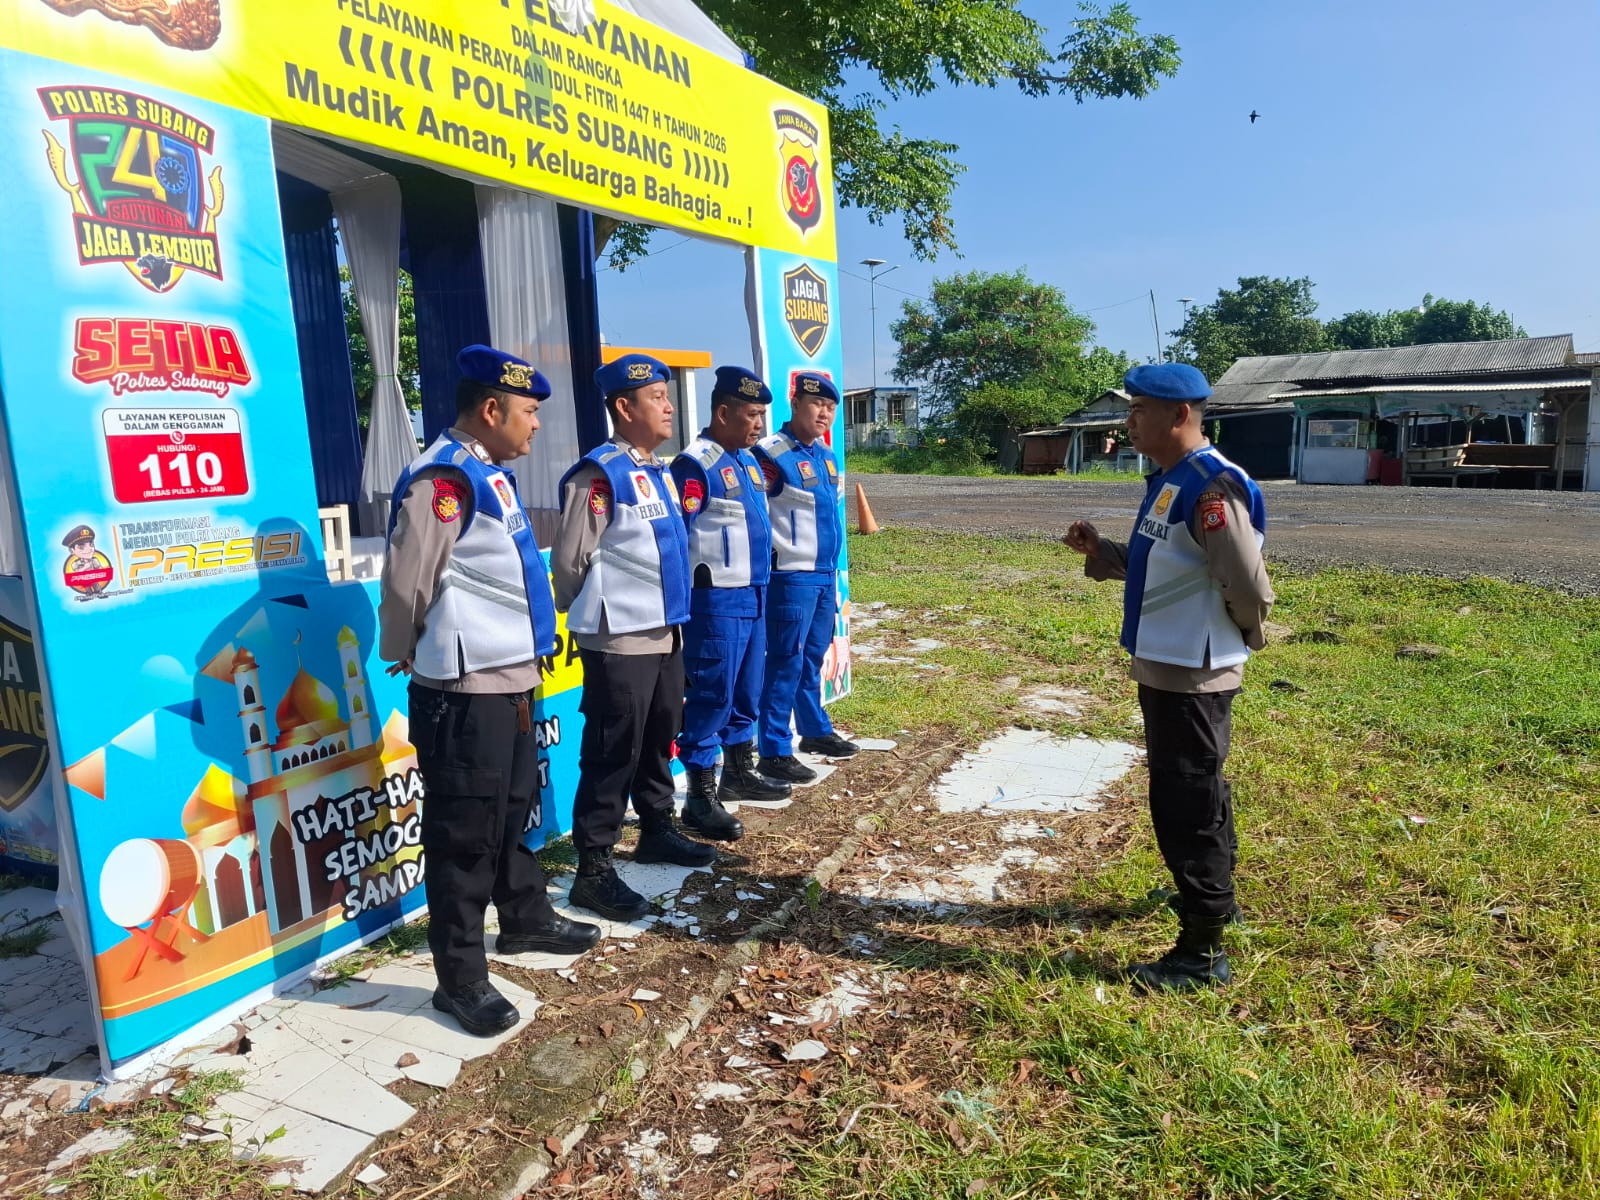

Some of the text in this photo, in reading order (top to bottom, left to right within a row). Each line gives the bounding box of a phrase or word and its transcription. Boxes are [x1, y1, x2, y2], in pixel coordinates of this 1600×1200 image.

[511, 24, 624, 89] DALAM RANGKA
[459, 33, 545, 86] PERAYAAN
[549, 68, 583, 100] IDUL
[584, 82, 619, 114] FITRI
[622, 97, 650, 125] 1447
[652, 109, 662, 130] H
[664, 113, 702, 145] TAHUN
[703, 129, 728, 154] 2026
[49, 90, 210, 148] POLRES SUBANG
[451, 65, 674, 169] POLRES SUBANG
[777, 113, 816, 139] JAWA BARAT
[285, 61, 407, 132] Mudik
[416, 105, 518, 169] Aman,
[526, 138, 637, 199] Keluarga
[643, 174, 722, 221] Bahagia
[80, 220, 218, 273] JAGA LEMBUR
[792, 278, 820, 301] JAGA
[785, 298, 828, 324] SUBANG
[74, 317, 250, 383] SETIA
[112, 370, 228, 395] Polres Subang
[118, 413, 226, 421] LAYANAN KEPOLISIAN
[124, 421, 224, 431] DALAM GENGGAMAN
[138, 452, 223, 489] 110
[639, 502, 665, 520] HERI
[119, 516, 210, 536] TRANSFORMASI
[122, 534, 174, 550] MENUJU
[211, 526, 241, 541] YANG
[1140, 518, 1170, 541] POLRI
[128, 532, 301, 578] PRESISI
